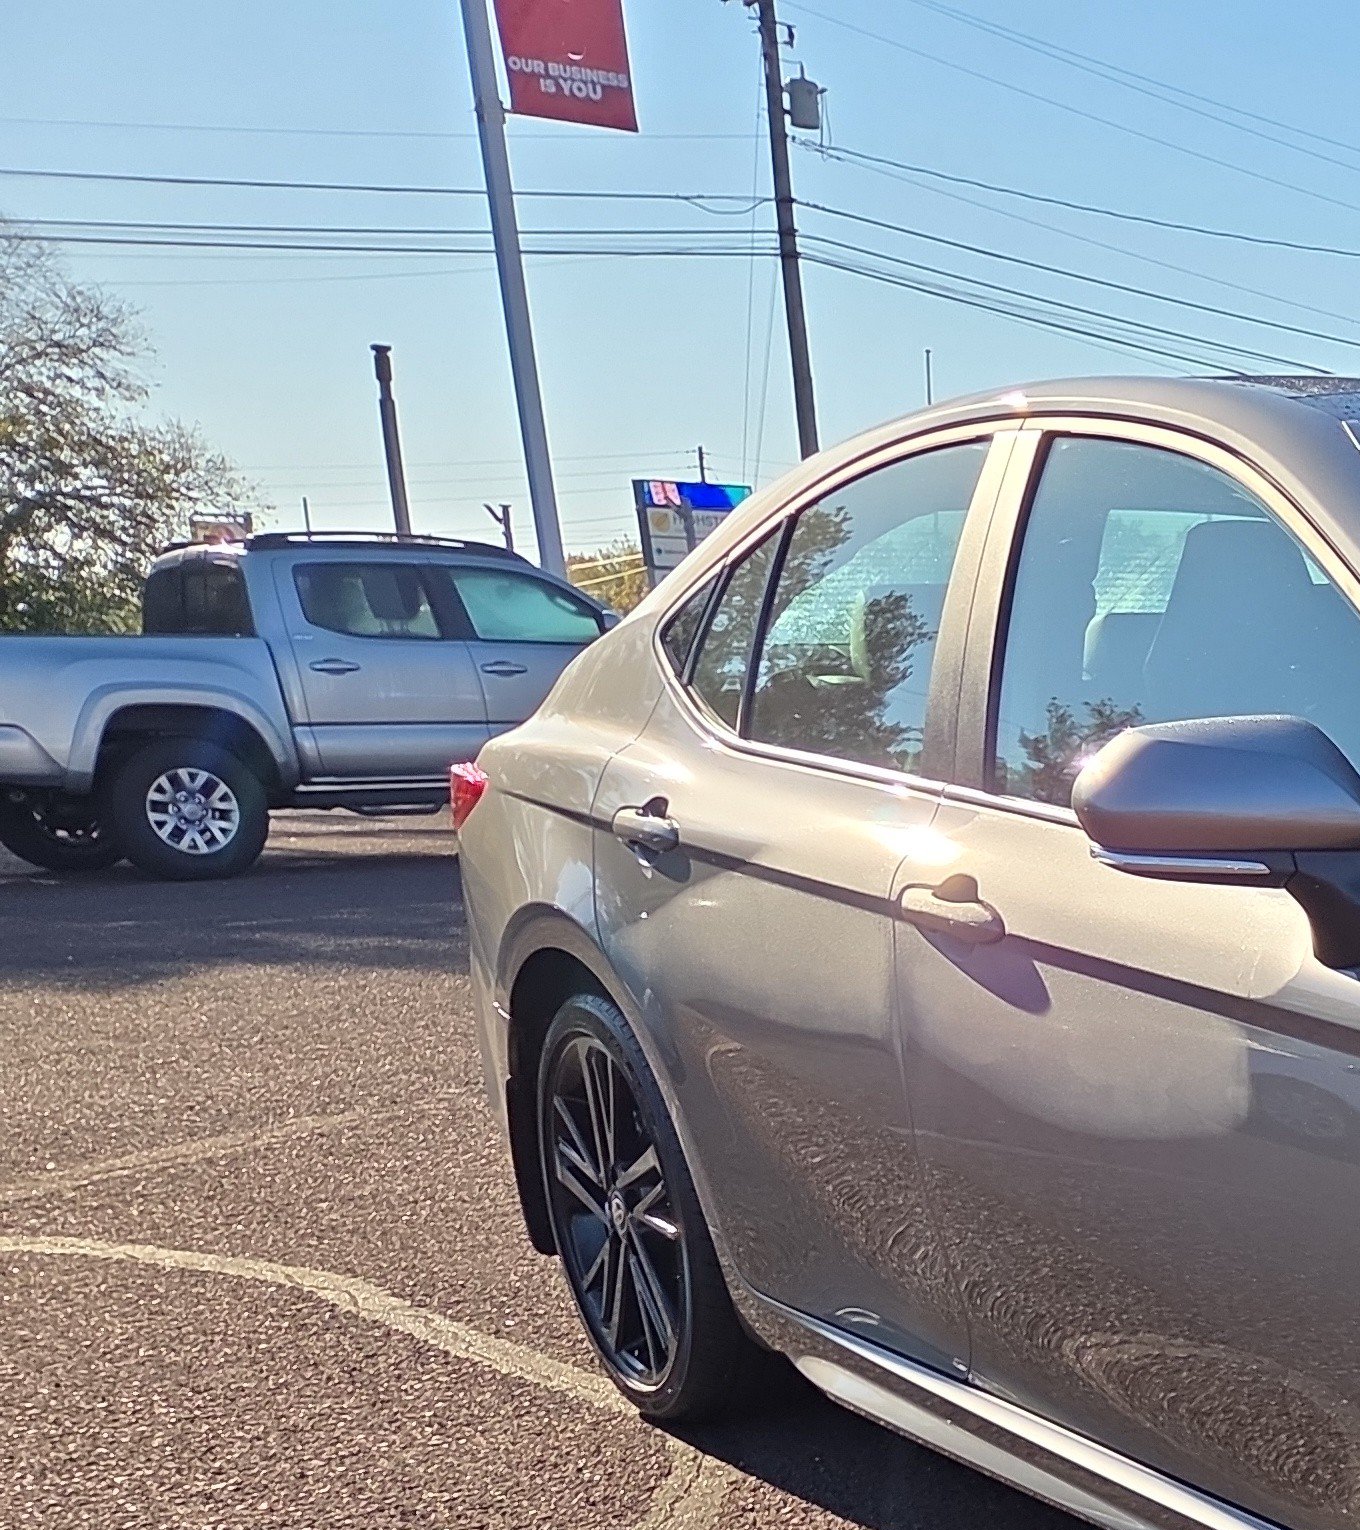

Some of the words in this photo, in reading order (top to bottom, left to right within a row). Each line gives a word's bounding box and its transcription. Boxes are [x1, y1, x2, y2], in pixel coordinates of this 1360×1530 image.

[507, 56, 545, 75] OUR
[547, 62, 629, 88] BUSINESS
[540, 78, 557, 93] IS
[558, 78, 602, 101] YOU
